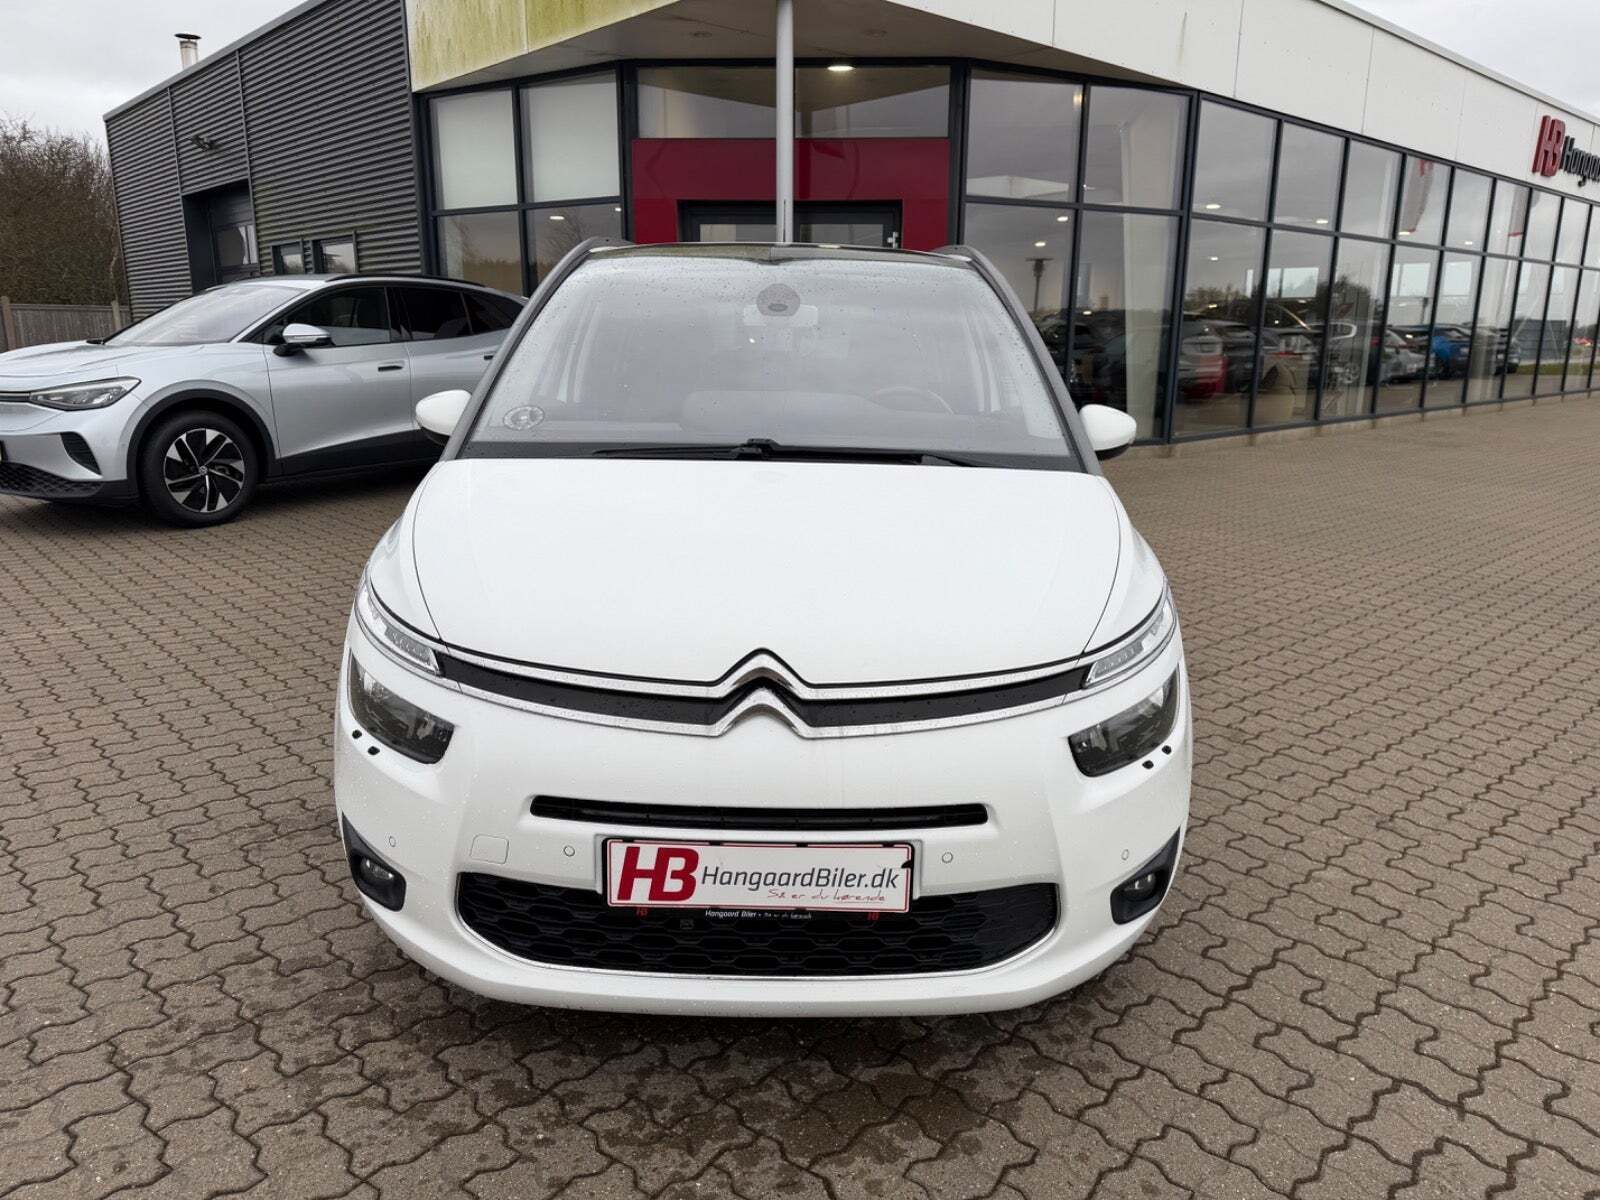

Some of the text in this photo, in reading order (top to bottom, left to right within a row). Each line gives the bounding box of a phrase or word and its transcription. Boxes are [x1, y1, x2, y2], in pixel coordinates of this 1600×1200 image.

[1532, 115, 1565, 177] HB
[617, 846, 699, 901] HB
[702, 866, 899, 891] HangaardBiler.dk
